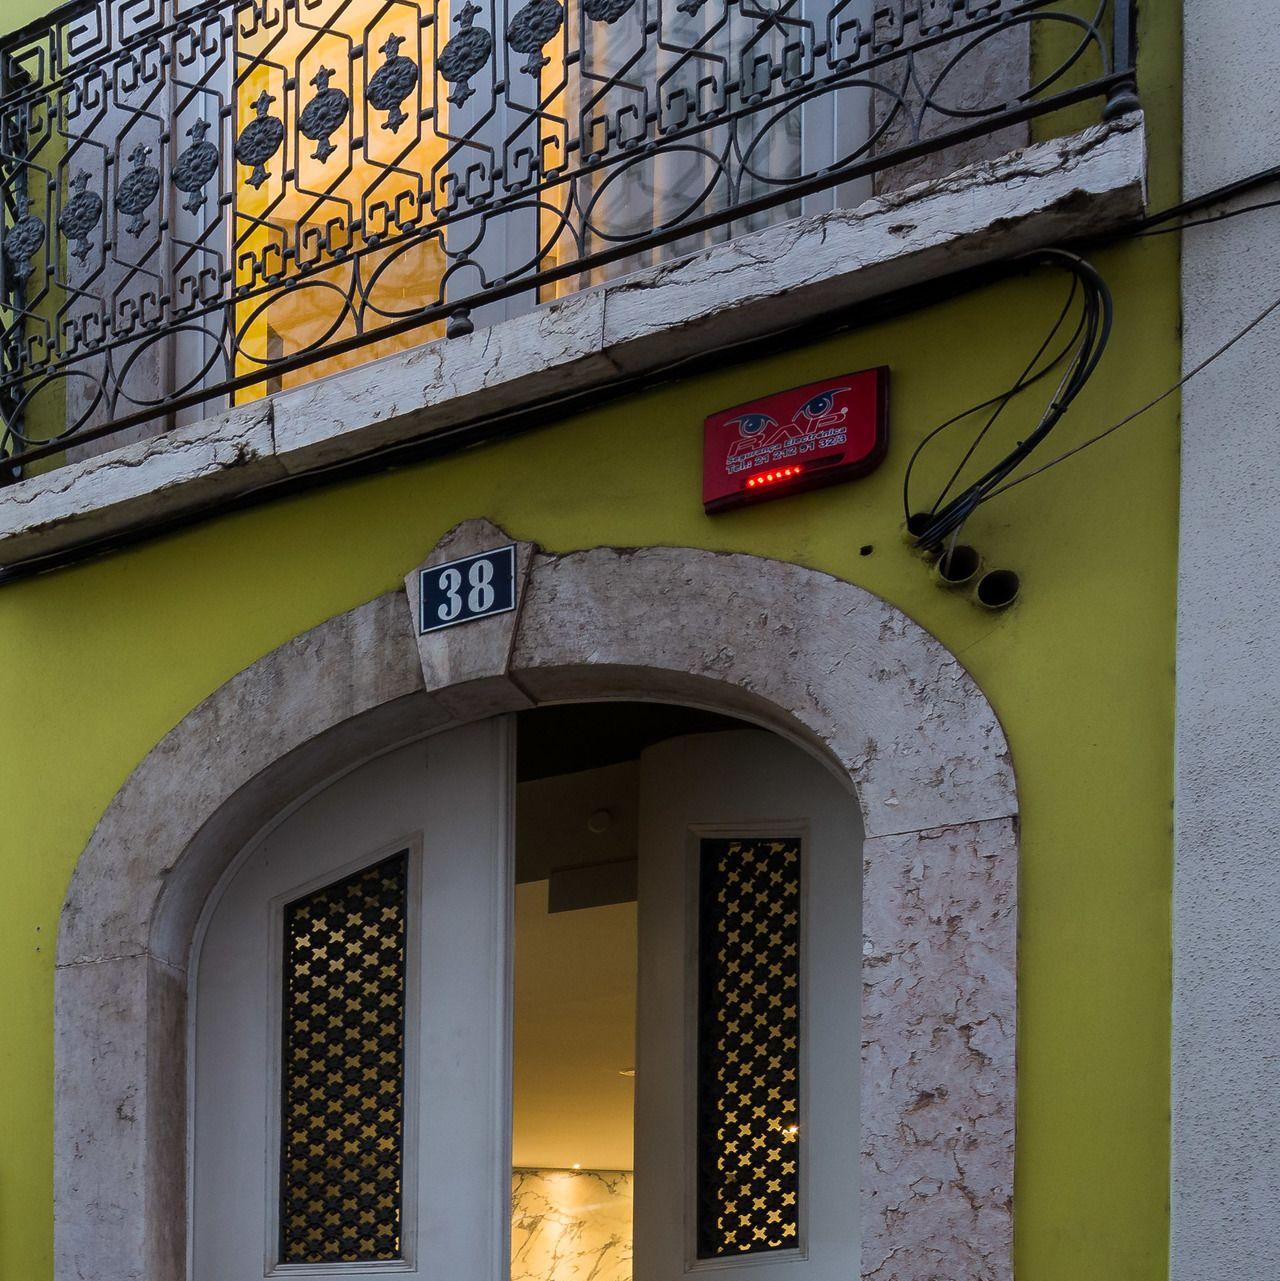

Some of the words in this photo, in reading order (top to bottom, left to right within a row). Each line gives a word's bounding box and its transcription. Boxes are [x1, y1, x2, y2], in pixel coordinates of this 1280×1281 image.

[754, 454, 769, 466] 21
[772, 446, 797, 460] 212
[799, 442, 815, 453] 91
[437, 559, 495, 621] 38
